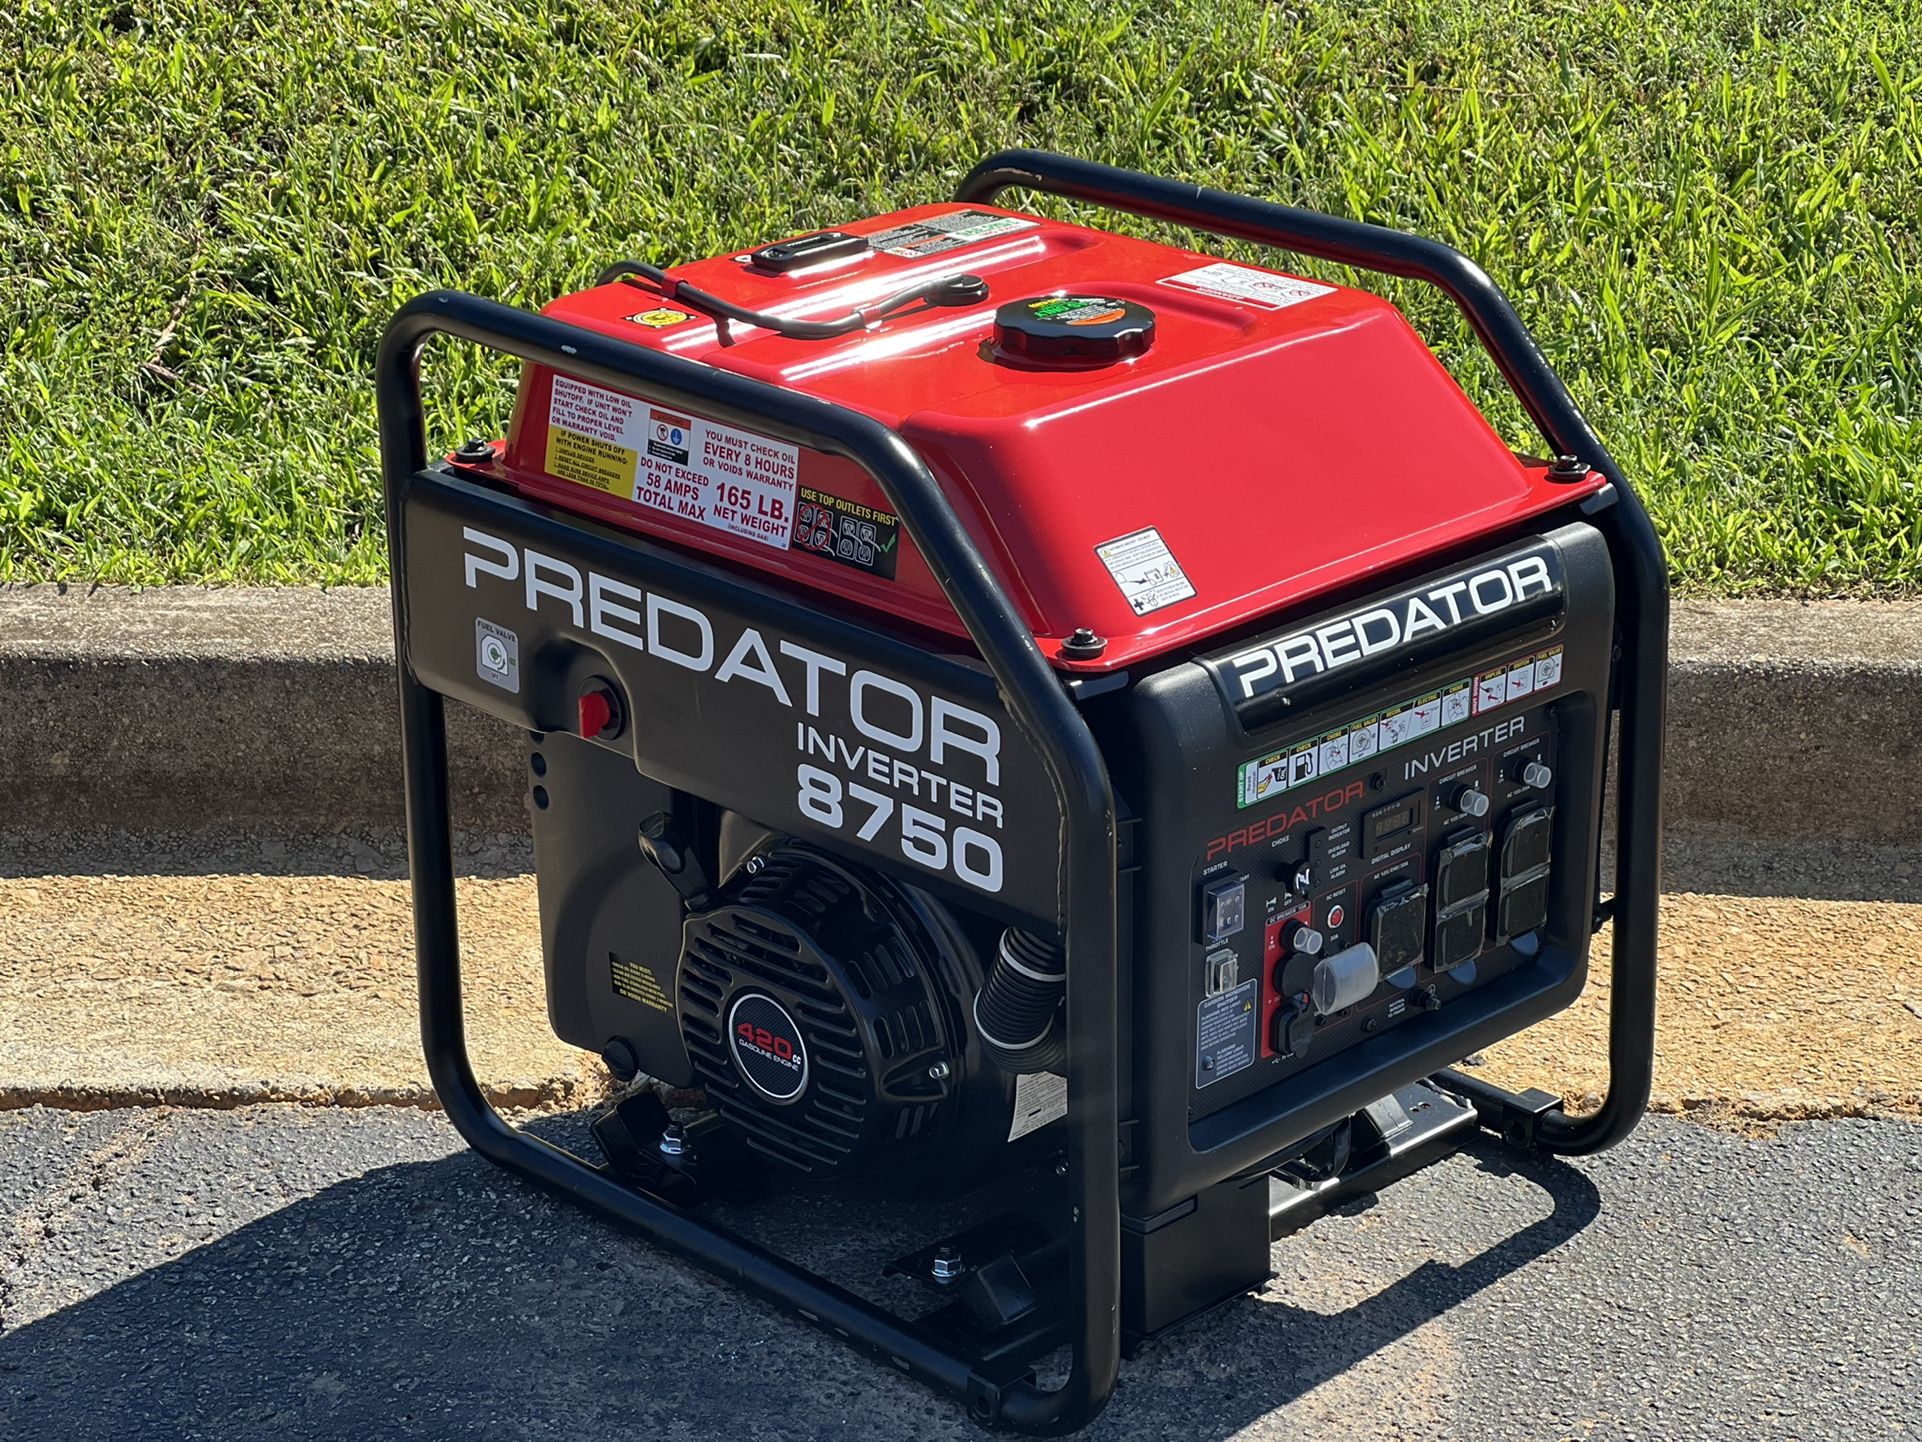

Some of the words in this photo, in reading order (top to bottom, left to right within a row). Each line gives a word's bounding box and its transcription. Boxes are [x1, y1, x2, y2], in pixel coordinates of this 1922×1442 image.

[554, 388, 584, 404] SHUTOFF.
[594, 400, 610, 411] UNIT
[611, 406, 632, 418] WON'T
[555, 379, 586, 396] EQUIPPED
[588, 389, 604, 400] WITH
[606, 394, 620, 404] LOW
[621, 399, 632, 408] OIL
[552, 406, 566, 416] FILL
[567, 410, 576, 420] TO
[577, 414, 602, 428] PROPER
[604, 423, 624, 435] LEVEL
[553, 398, 573, 408] START
[574, 404, 596, 416] CHECK
[598, 411, 608, 420] OIL
[610, 415, 624, 425] AND
[552, 416, 561, 424] OR
[562, 418, 597, 436] WARRANTY
[599, 430, 616, 442] VOID.
[568, 432, 590, 444] POWER
[591, 438, 612, 450] SHUTS
[614, 446, 625, 455] OFF
[556, 436, 572, 448] WITH
[573, 442, 596, 456] ENGINE
[598, 448, 628, 466] RUNNING:
[704, 441, 741, 464] EVERY
[744, 453, 751, 467] 8
[755, 456, 794, 480] HOURS
[705, 429, 722, 442] YOU
[724, 435, 748, 450] MUST
[750, 443, 779, 460] CHECK
[782, 452, 796, 464] OIL
[640, 456, 652, 469] DO
[655, 460, 672, 476] NOT
[675, 468, 709, 486] EXCEED
[646, 472, 661, 489] 58
[664, 478, 700, 501] AMPS
[703, 456, 715, 468] OR
[718, 460, 743, 476] VOIDS
[746, 469, 794, 492] WARRANTY
[636, 486, 674, 511] TOTAL
[678, 500, 706, 521] MAX
[716, 482, 752, 510] 165
[758, 494, 790, 523] LB.
[801, 488, 816, 502] USE
[819, 493, 834, 506] TOP
[836, 499, 871, 519] OUTLETS
[873, 510, 896, 526] FIRST
[714, 504, 737, 522] NET
[740, 512, 788, 538] WEIGHT
[478, 620, 494, 633] FUEL
[495, 627, 516, 642] VALVE
[1233, 556, 1552, 698] PREDATOR
[462, 525, 1000, 787] PREDATOR
[1404, 716, 1524, 780] INVERTER
[798, 722, 1003, 828] INVERTER
[798, 762, 1003, 893] 8750
[1206, 780, 1365, 862] PREDATOR
[1271, 834, 1290, 848] CHOKE
[1203, 860, 1228, 876] STARTER
[737, 1022, 794, 1061] 420
[738, 1038, 772, 1060] GASOLINE
[773, 1054, 799, 1072] ENGINE
